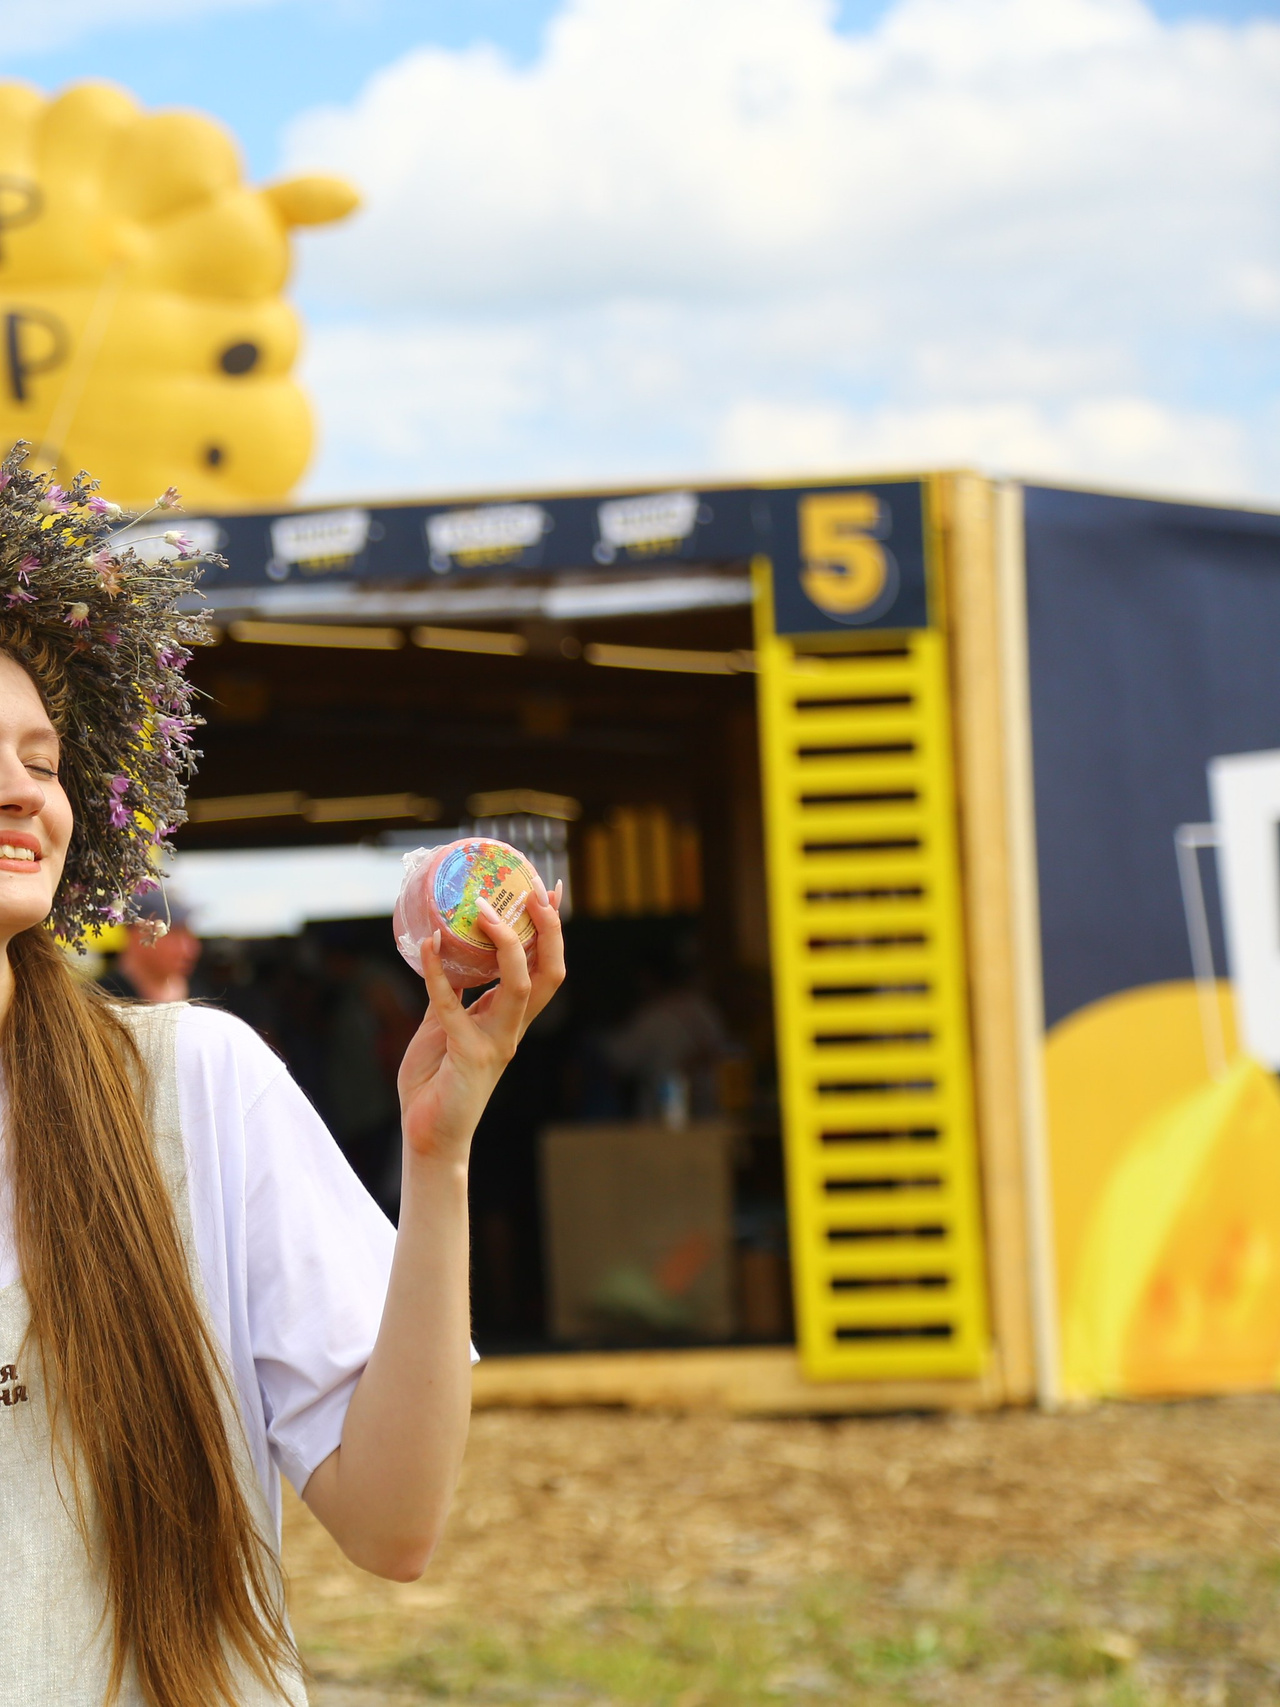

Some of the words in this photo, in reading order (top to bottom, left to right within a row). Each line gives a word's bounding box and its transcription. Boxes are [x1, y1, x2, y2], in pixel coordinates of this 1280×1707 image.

[797, 491, 888, 616] 5
[491, 889, 507, 908] илая
[496, 892, 514, 916] ревня
[507, 903, 526, 928] ОМАТАМИ
